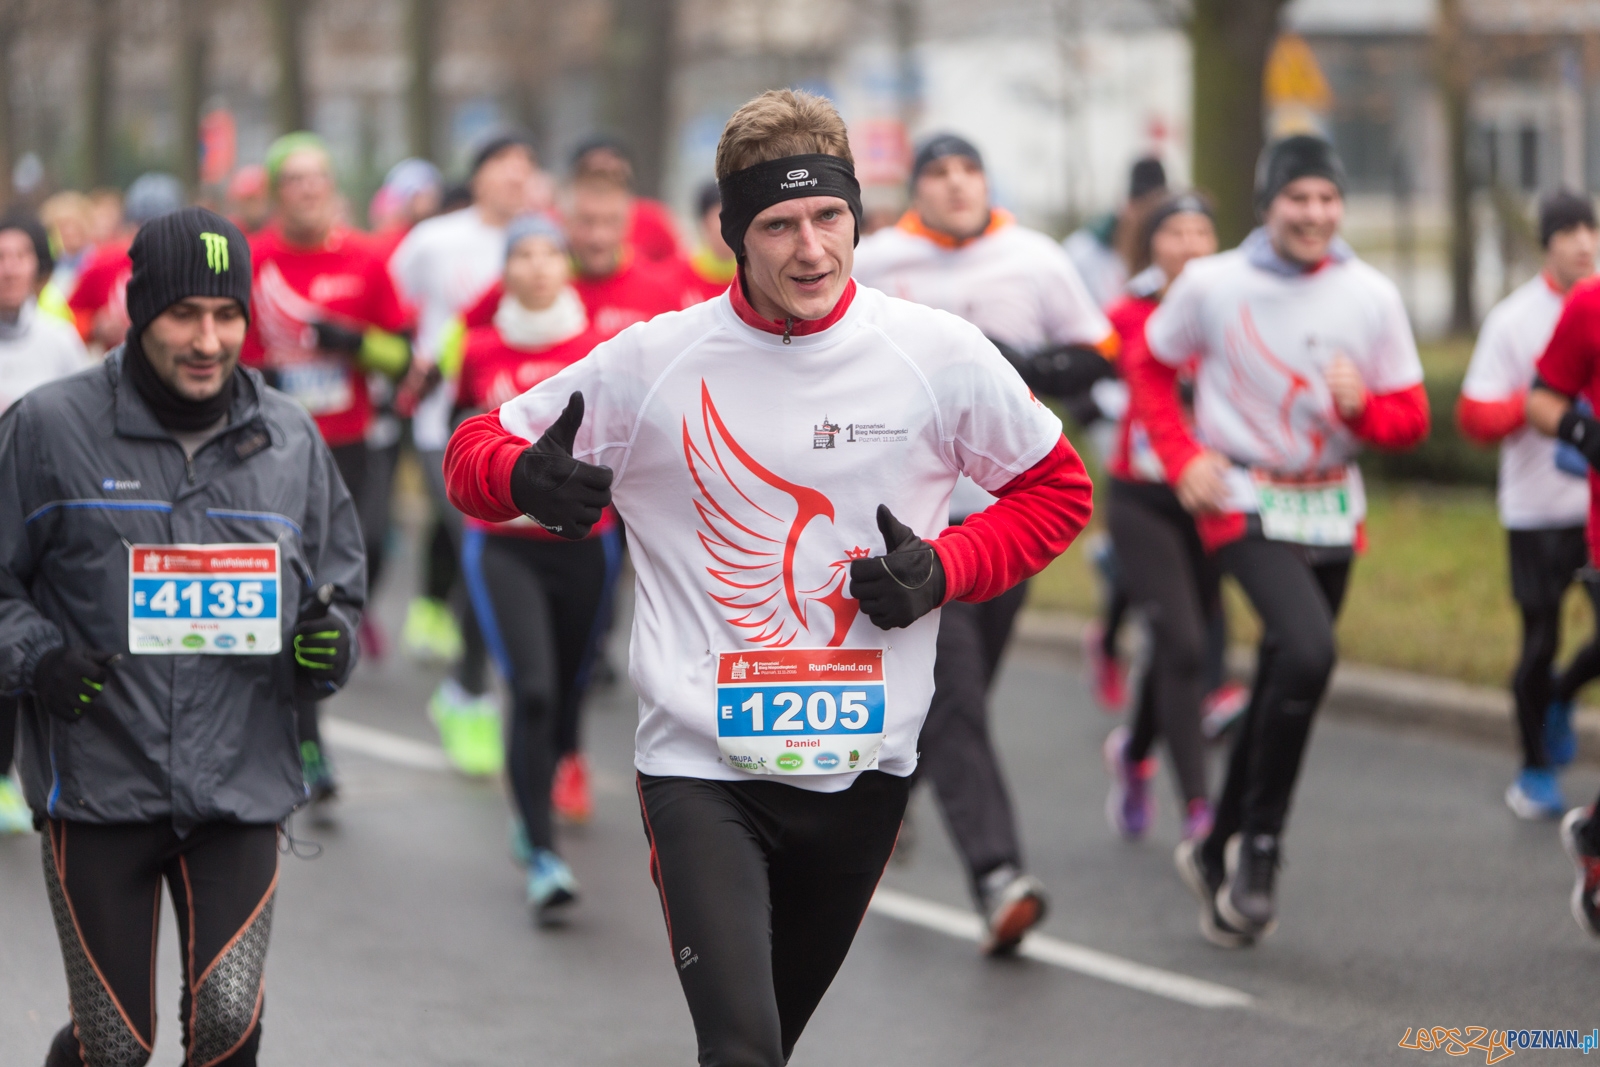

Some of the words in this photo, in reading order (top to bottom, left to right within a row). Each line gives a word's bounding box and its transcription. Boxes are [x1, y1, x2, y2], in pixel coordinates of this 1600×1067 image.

[780, 178, 818, 189] Kalenji
[846, 424, 856, 442] 1
[210, 557, 269, 569] RunPoland.org
[134, 591, 147, 606] E
[149, 581, 265, 617] 4135
[752, 662, 760, 675] 1
[808, 662, 873, 674] RunPoland.org
[721, 705, 733, 720] E
[741, 691, 870, 732] 1205
[785, 739, 821, 748] Daniel
